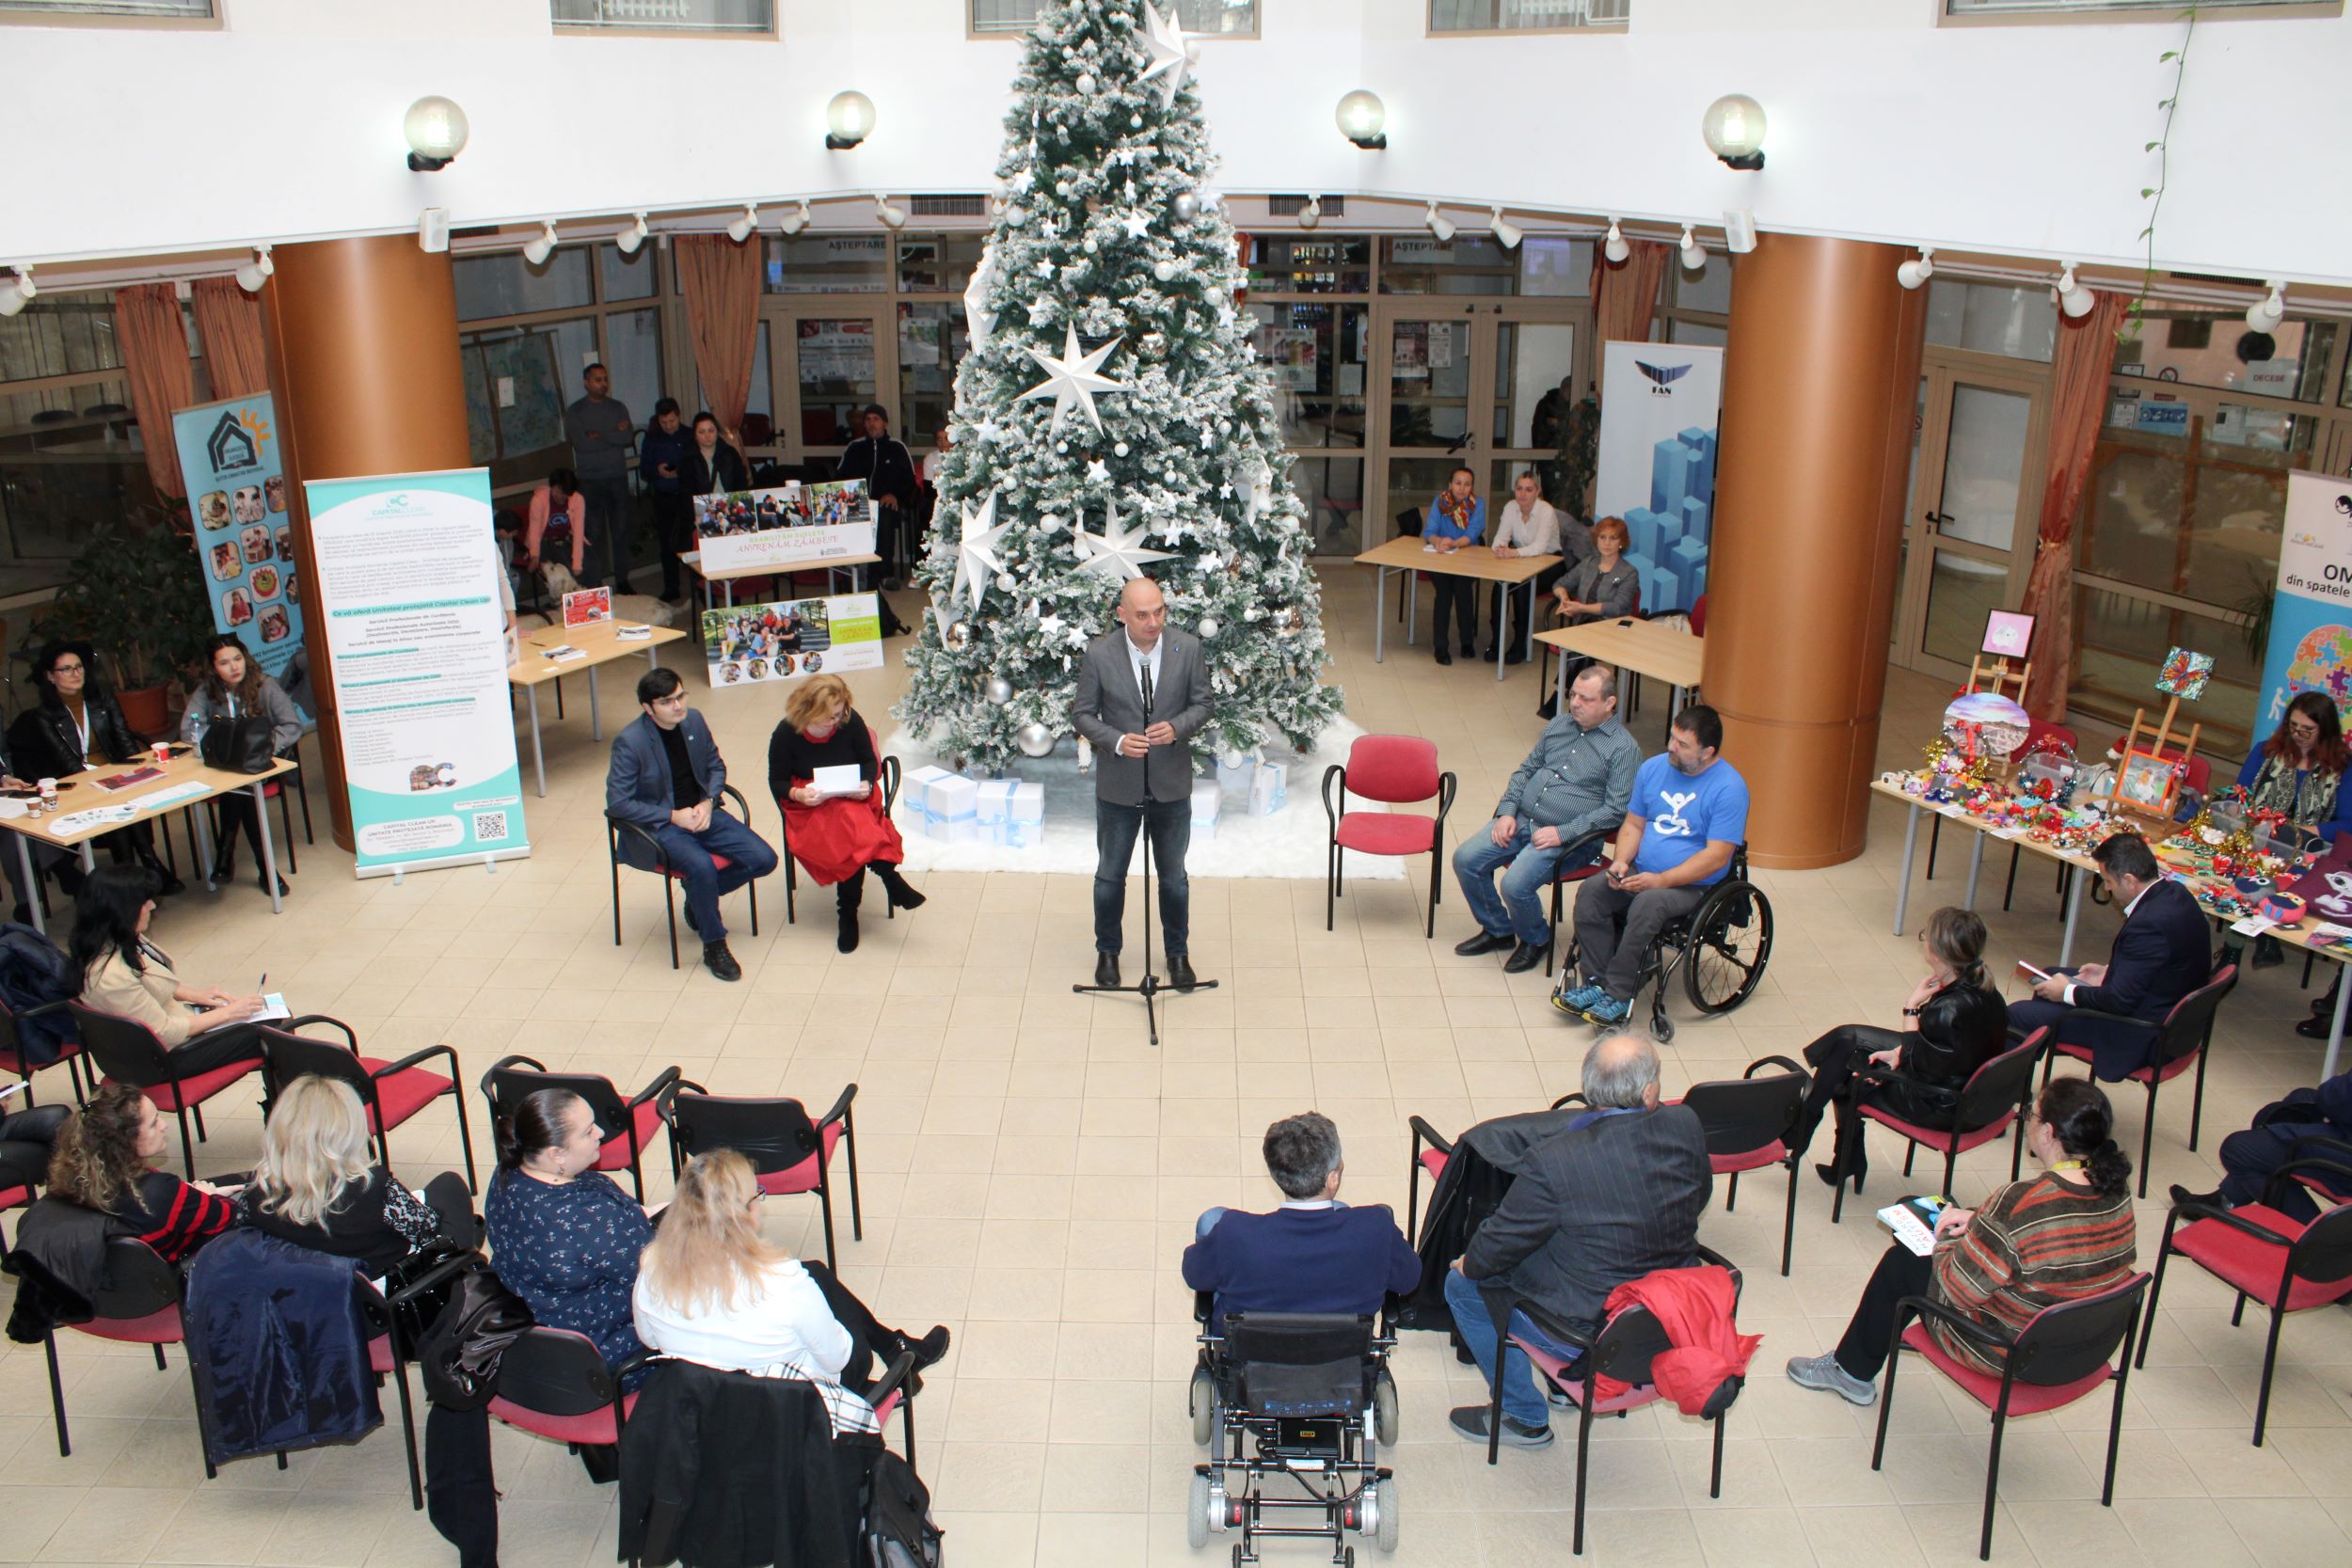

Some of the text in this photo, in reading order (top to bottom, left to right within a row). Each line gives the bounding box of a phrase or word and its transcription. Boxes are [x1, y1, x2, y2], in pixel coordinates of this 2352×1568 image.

[2287, 574, 2350, 597] din spatele
[435, 599, 459, 608] Capital
